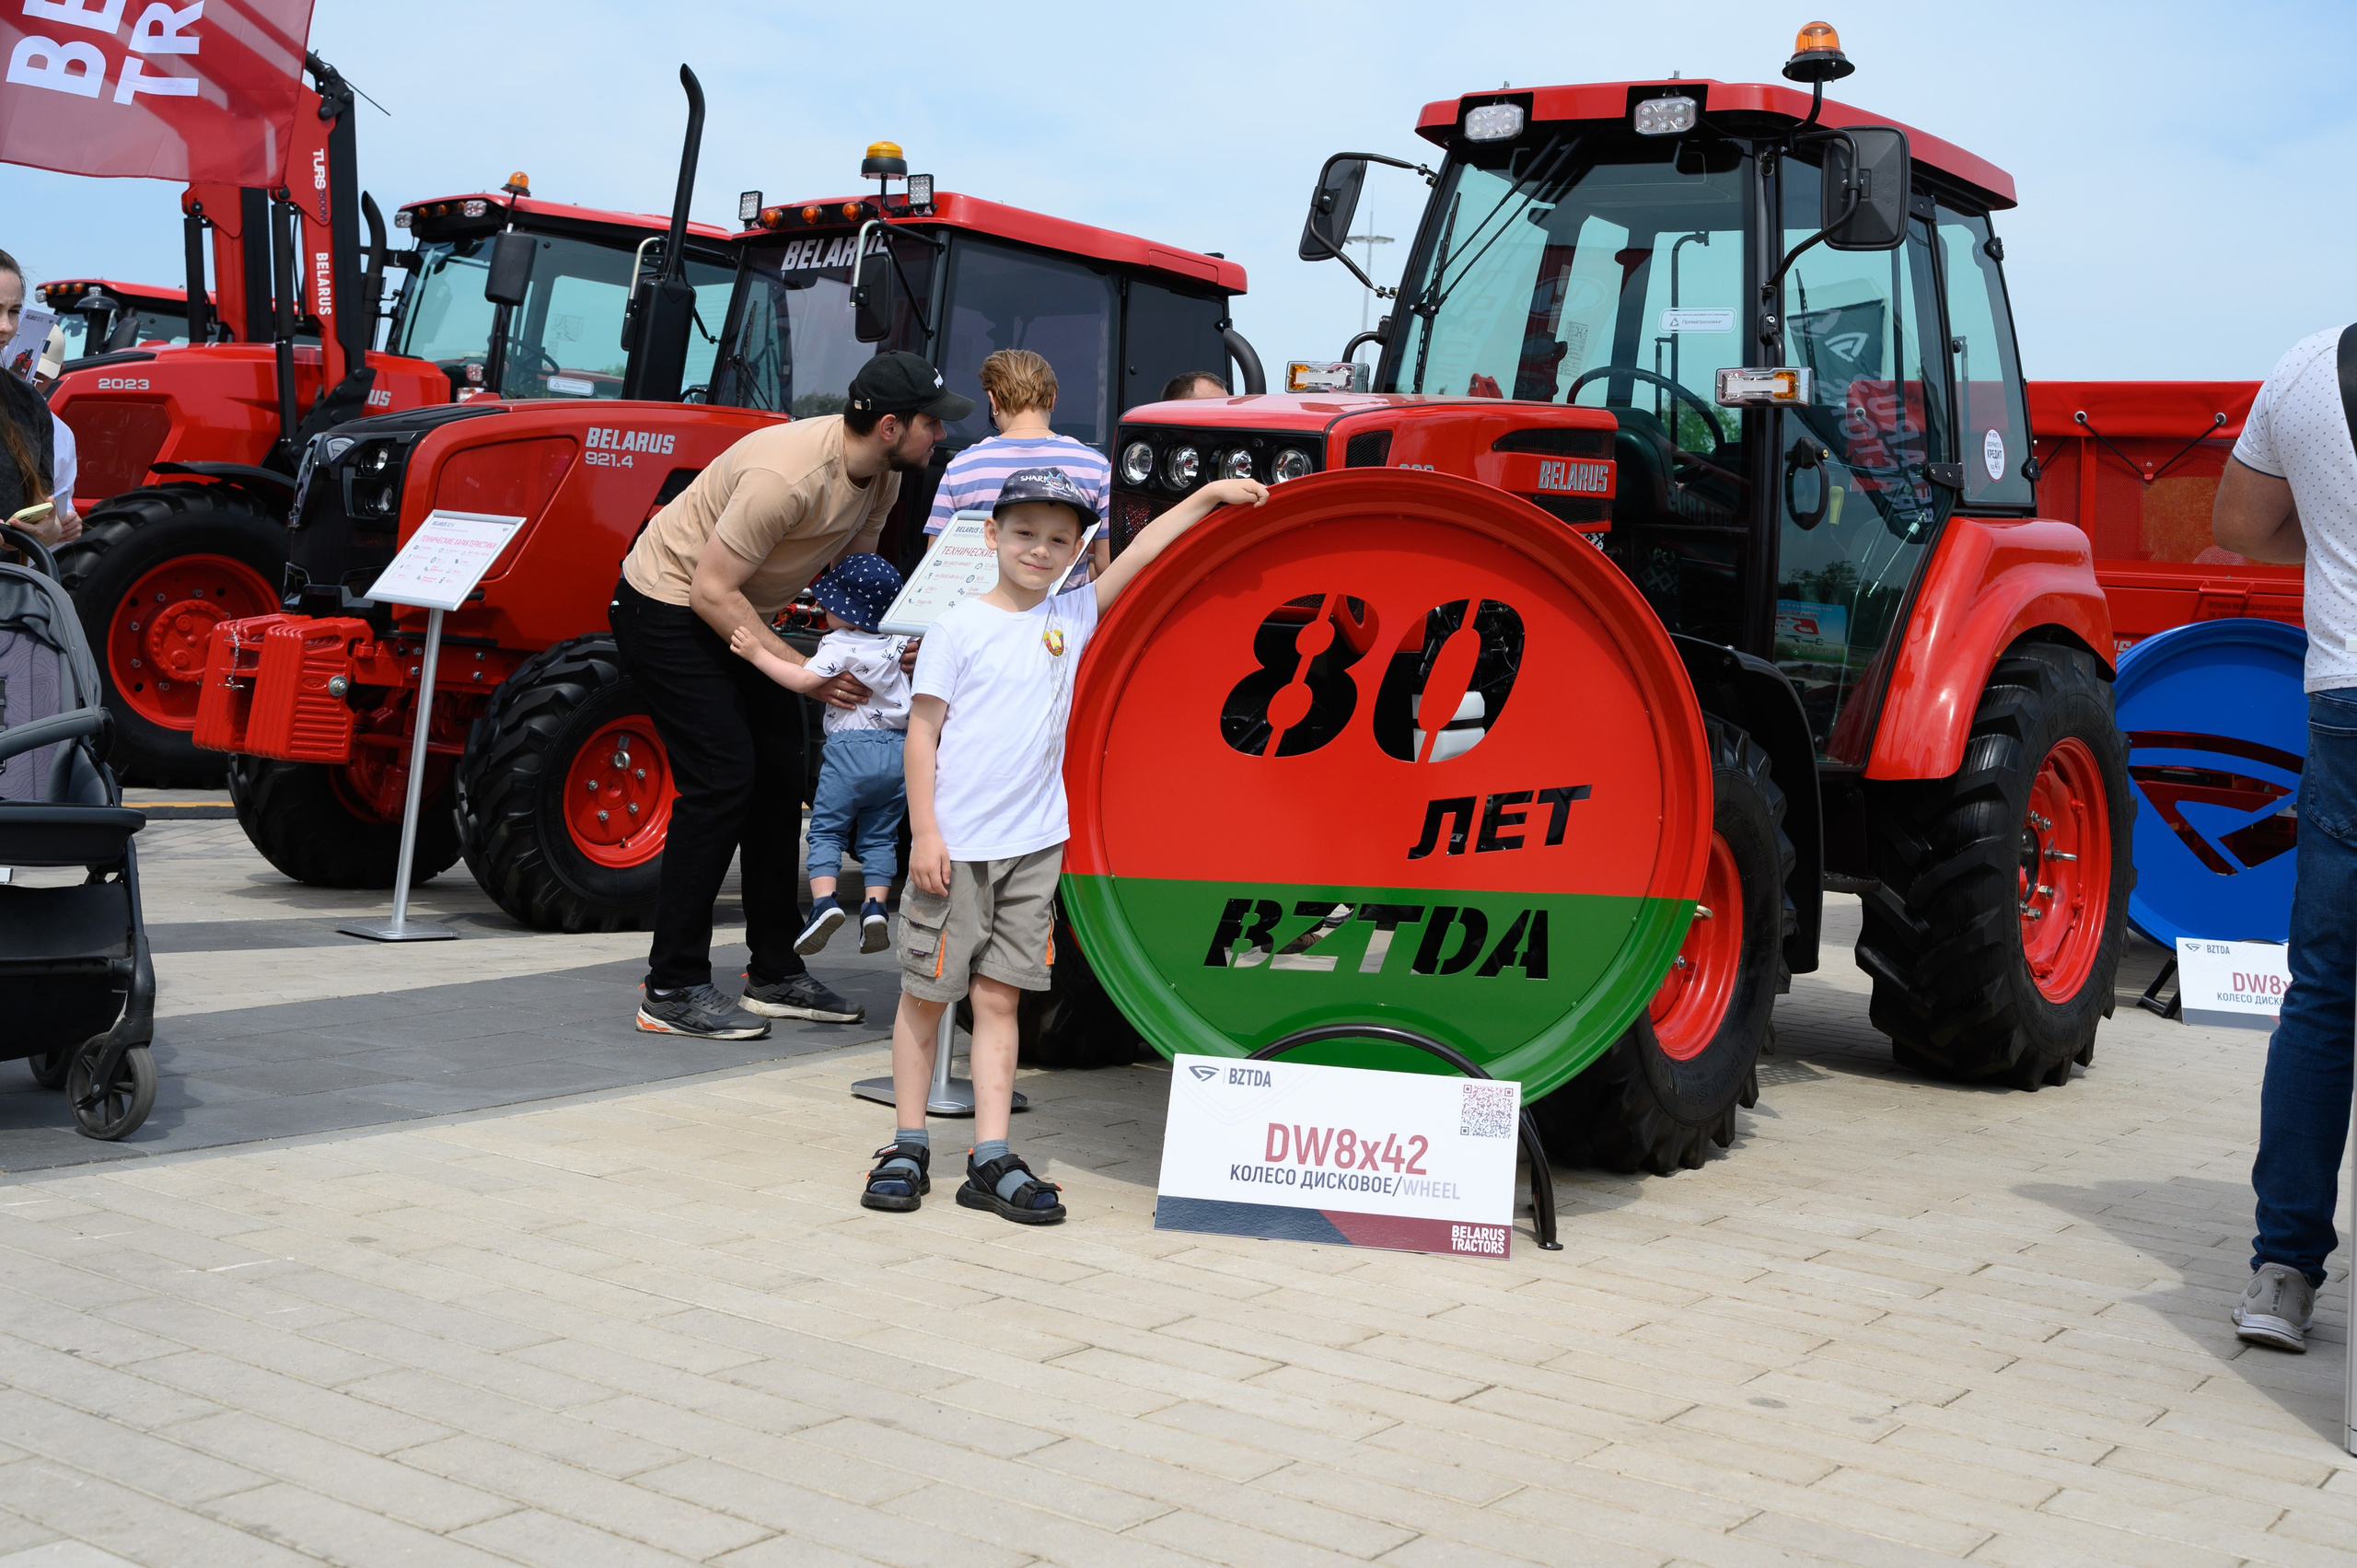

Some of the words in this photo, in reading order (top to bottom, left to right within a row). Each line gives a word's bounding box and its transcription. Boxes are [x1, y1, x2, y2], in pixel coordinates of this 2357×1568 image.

[313, 148, 326, 190] TURS
[316, 252, 331, 316] BELARUS
[98, 377, 150, 390] 2023
[586, 426, 676, 455] BELARUS
[585, 451, 633, 468] 921.4
[1538, 460, 1608, 493] BELARUS
[942, 546, 995, 558] ТЕХНИЧЕСКИЕ
[1220, 592, 1526, 763] 80
[1407, 784, 1593, 860] ЛЕТ
[1203, 898, 1549, 981] BZTDA
[2207, 945, 2230, 955] BZTDA
[2217, 993, 2252, 1003] КОЛЕСО
[1229, 1068, 1271, 1087] BZTDA
[1264, 1122, 1429, 1176] DW8x42
[1230, 1164, 1296, 1185] КОЛЕСО
[1452, 1225, 1505, 1242] BELARUS
[1451, 1237, 1504, 1254] TRACTORS
